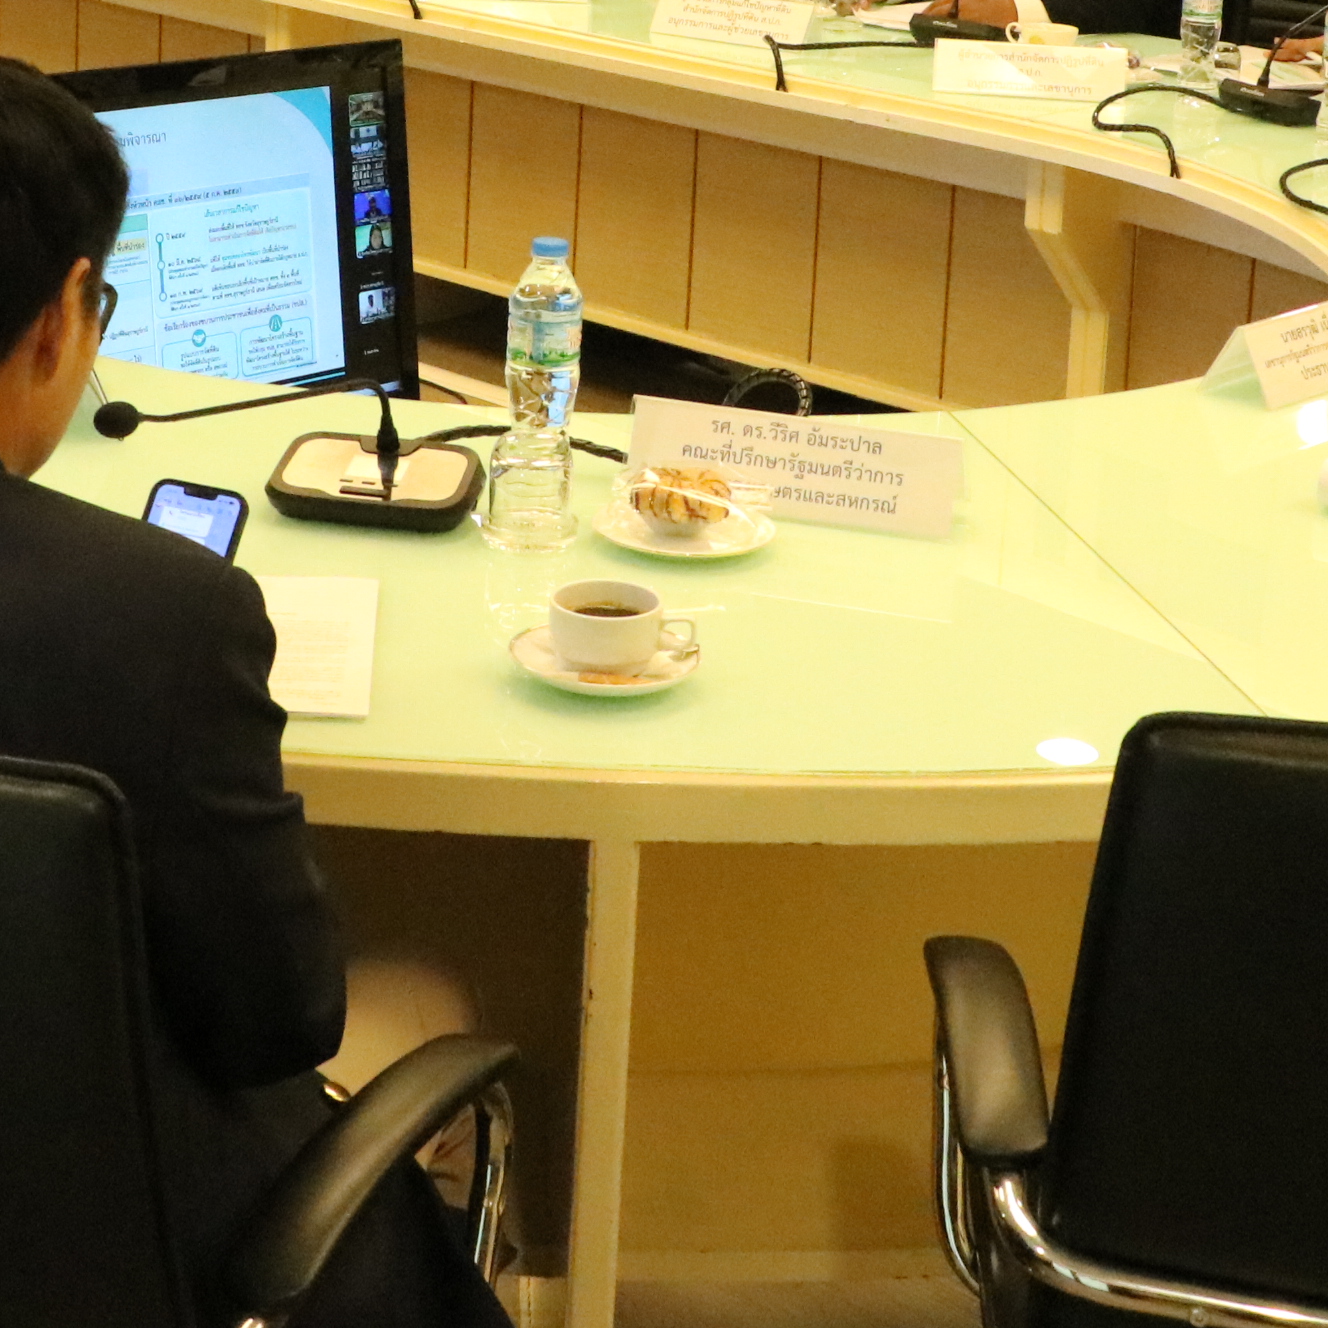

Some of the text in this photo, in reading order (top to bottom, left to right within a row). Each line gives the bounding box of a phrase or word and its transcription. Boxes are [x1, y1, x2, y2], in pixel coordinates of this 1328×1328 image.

[120, 132, 167, 147] มพิจารณา
[711, 420, 734, 436] รศ.
[807, 426, 883, 456] อัมระปาล
[682, 441, 904, 488] คณะที่ปรึกษารัฐมนตรีว่าการ
[769, 482, 897, 515] ษตรและสหกรณ์
